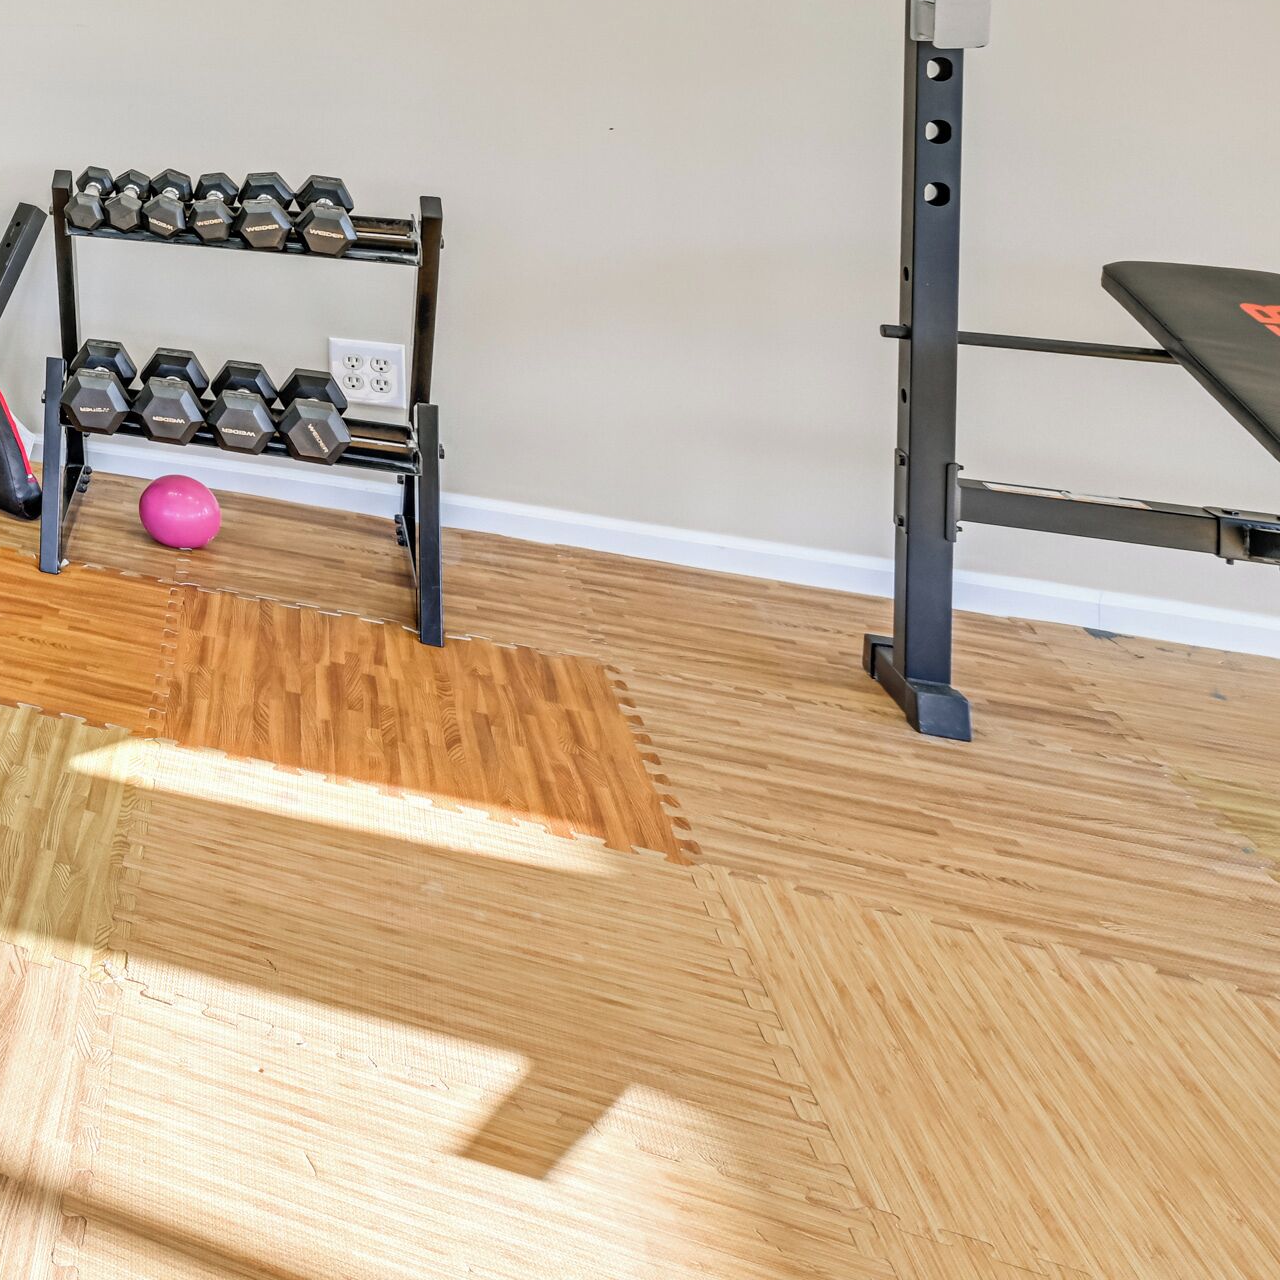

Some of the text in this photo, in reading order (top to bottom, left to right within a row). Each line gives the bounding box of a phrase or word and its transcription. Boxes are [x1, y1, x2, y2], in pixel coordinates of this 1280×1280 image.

[244, 224, 280, 233] WEIDER
[309, 228, 344, 239] WEIDER
[152, 415, 186, 424] WEIDER
[221, 427, 256, 437] WEIDER
[307, 422, 329, 454] WEIDER
